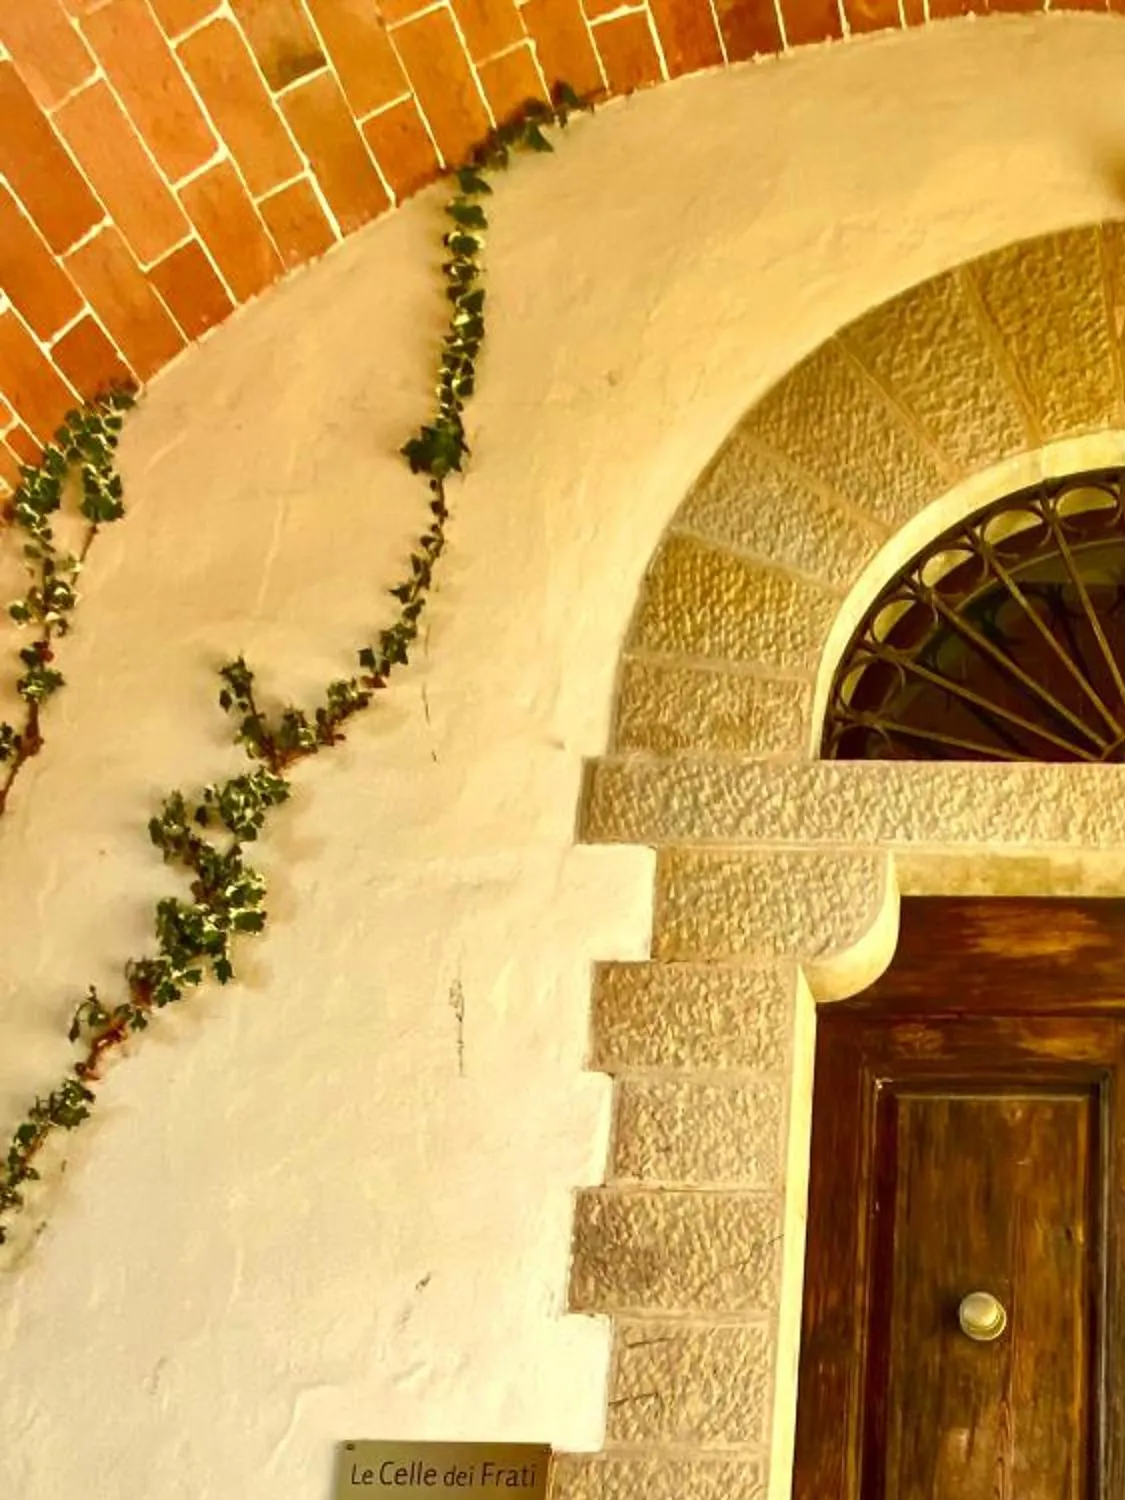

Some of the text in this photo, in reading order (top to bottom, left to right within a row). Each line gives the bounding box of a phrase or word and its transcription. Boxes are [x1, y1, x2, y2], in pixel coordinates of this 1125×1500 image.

[351, 1460, 537, 1488] Le Celle dei Frati
